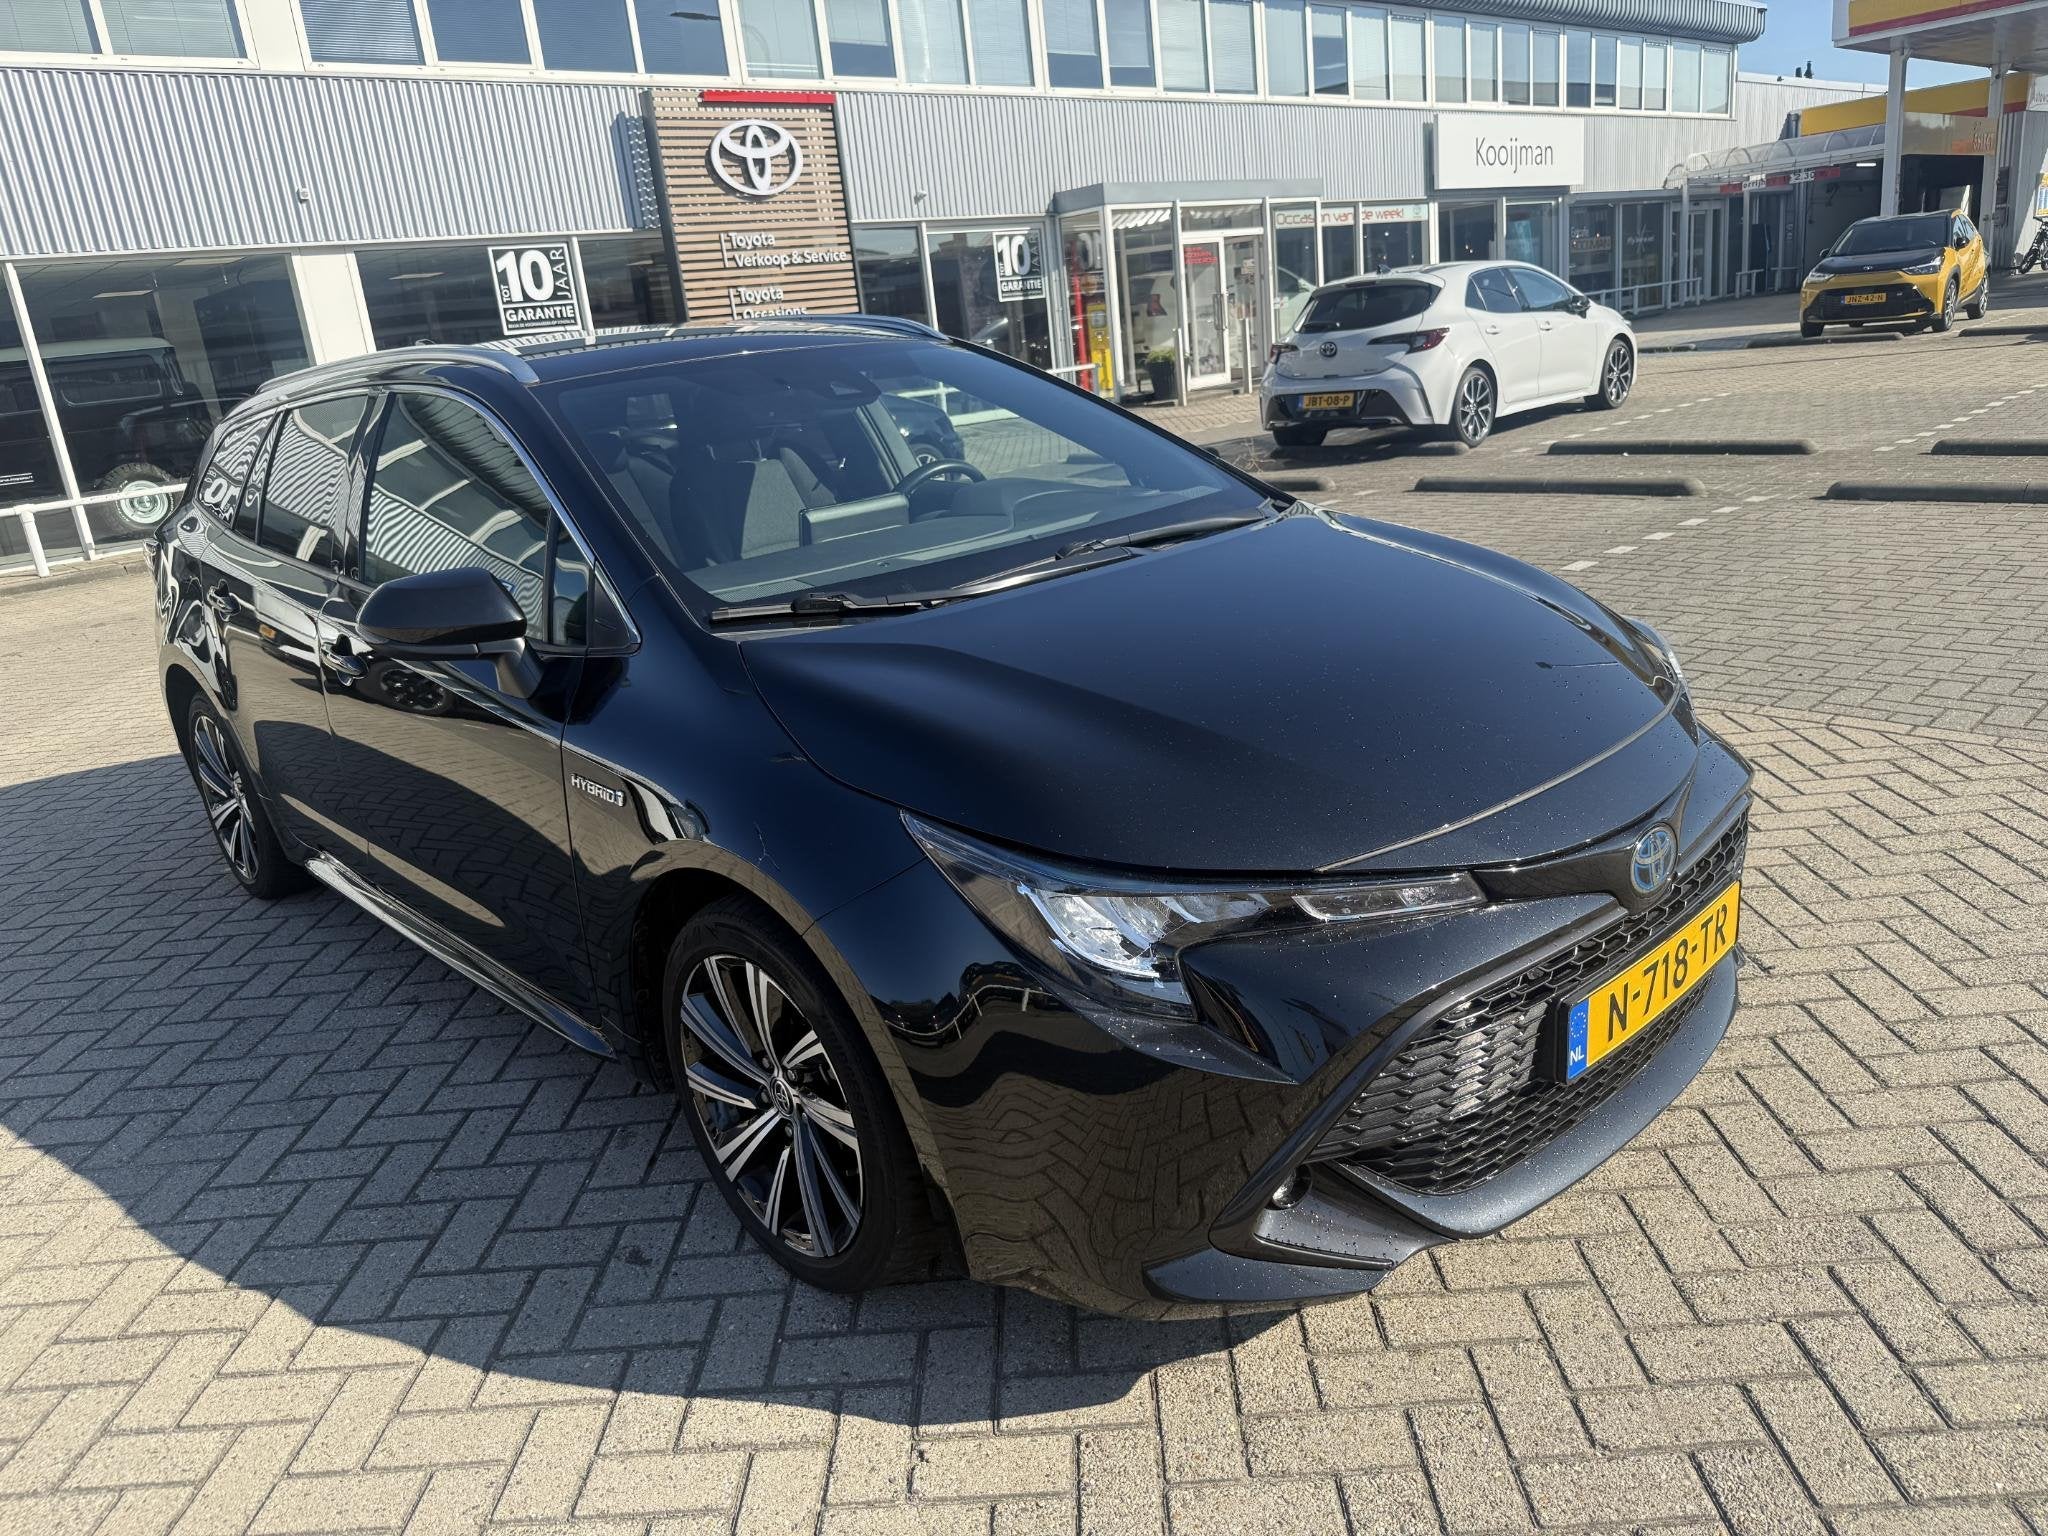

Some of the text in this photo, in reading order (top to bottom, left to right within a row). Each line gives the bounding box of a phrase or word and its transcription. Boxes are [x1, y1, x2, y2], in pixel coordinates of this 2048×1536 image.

[1475, 137, 1553, 173] Kooijman
[1335, 211, 1354, 223] van
[1376, 208, 1404, 219] week!
[729, 231, 775, 250] Toyota
[734, 248, 847, 269] Verkoop & Service
[998, 235, 1031, 276] 10
[496, 248, 572, 302] TOT 10 JAAR
[738, 286, 784, 305] Toyota
[505, 305, 575, 322] GARANTIE
[1305, 394, 1351, 407] JBT-08-P
[571, 774, 615, 803] HYBRID
[1607, 903, 1728, 1042] N-718-TR
[1569, 1049, 1585, 1066] NL
